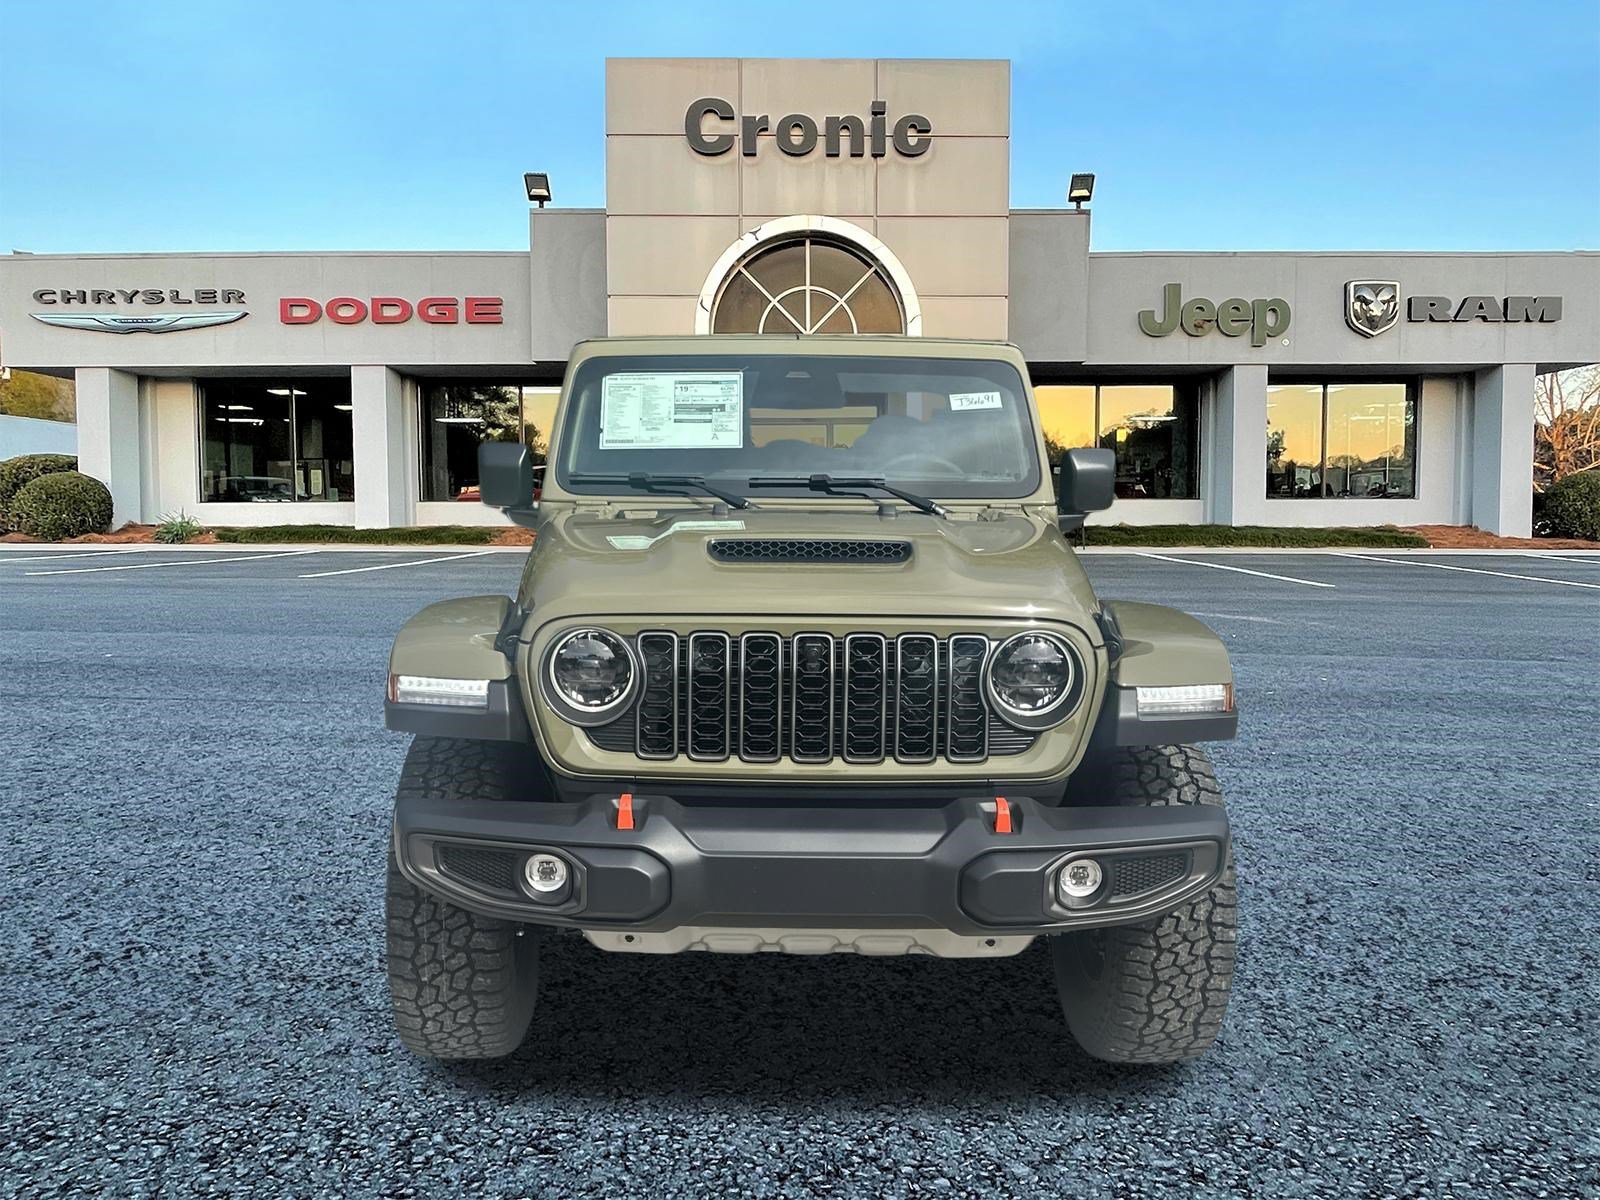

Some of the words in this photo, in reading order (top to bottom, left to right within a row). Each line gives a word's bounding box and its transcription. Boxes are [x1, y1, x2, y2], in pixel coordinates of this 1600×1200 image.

[684, 98, 933, 158] Cronic
[32, 288, 246, 305] CHRYSLER
[1407, 296, 1563, 323] RAM
[279, 297, 504, 325] DODGE
[1138, 283, 1292, 347] Jeep
[680, 385, 689, 393] 19
